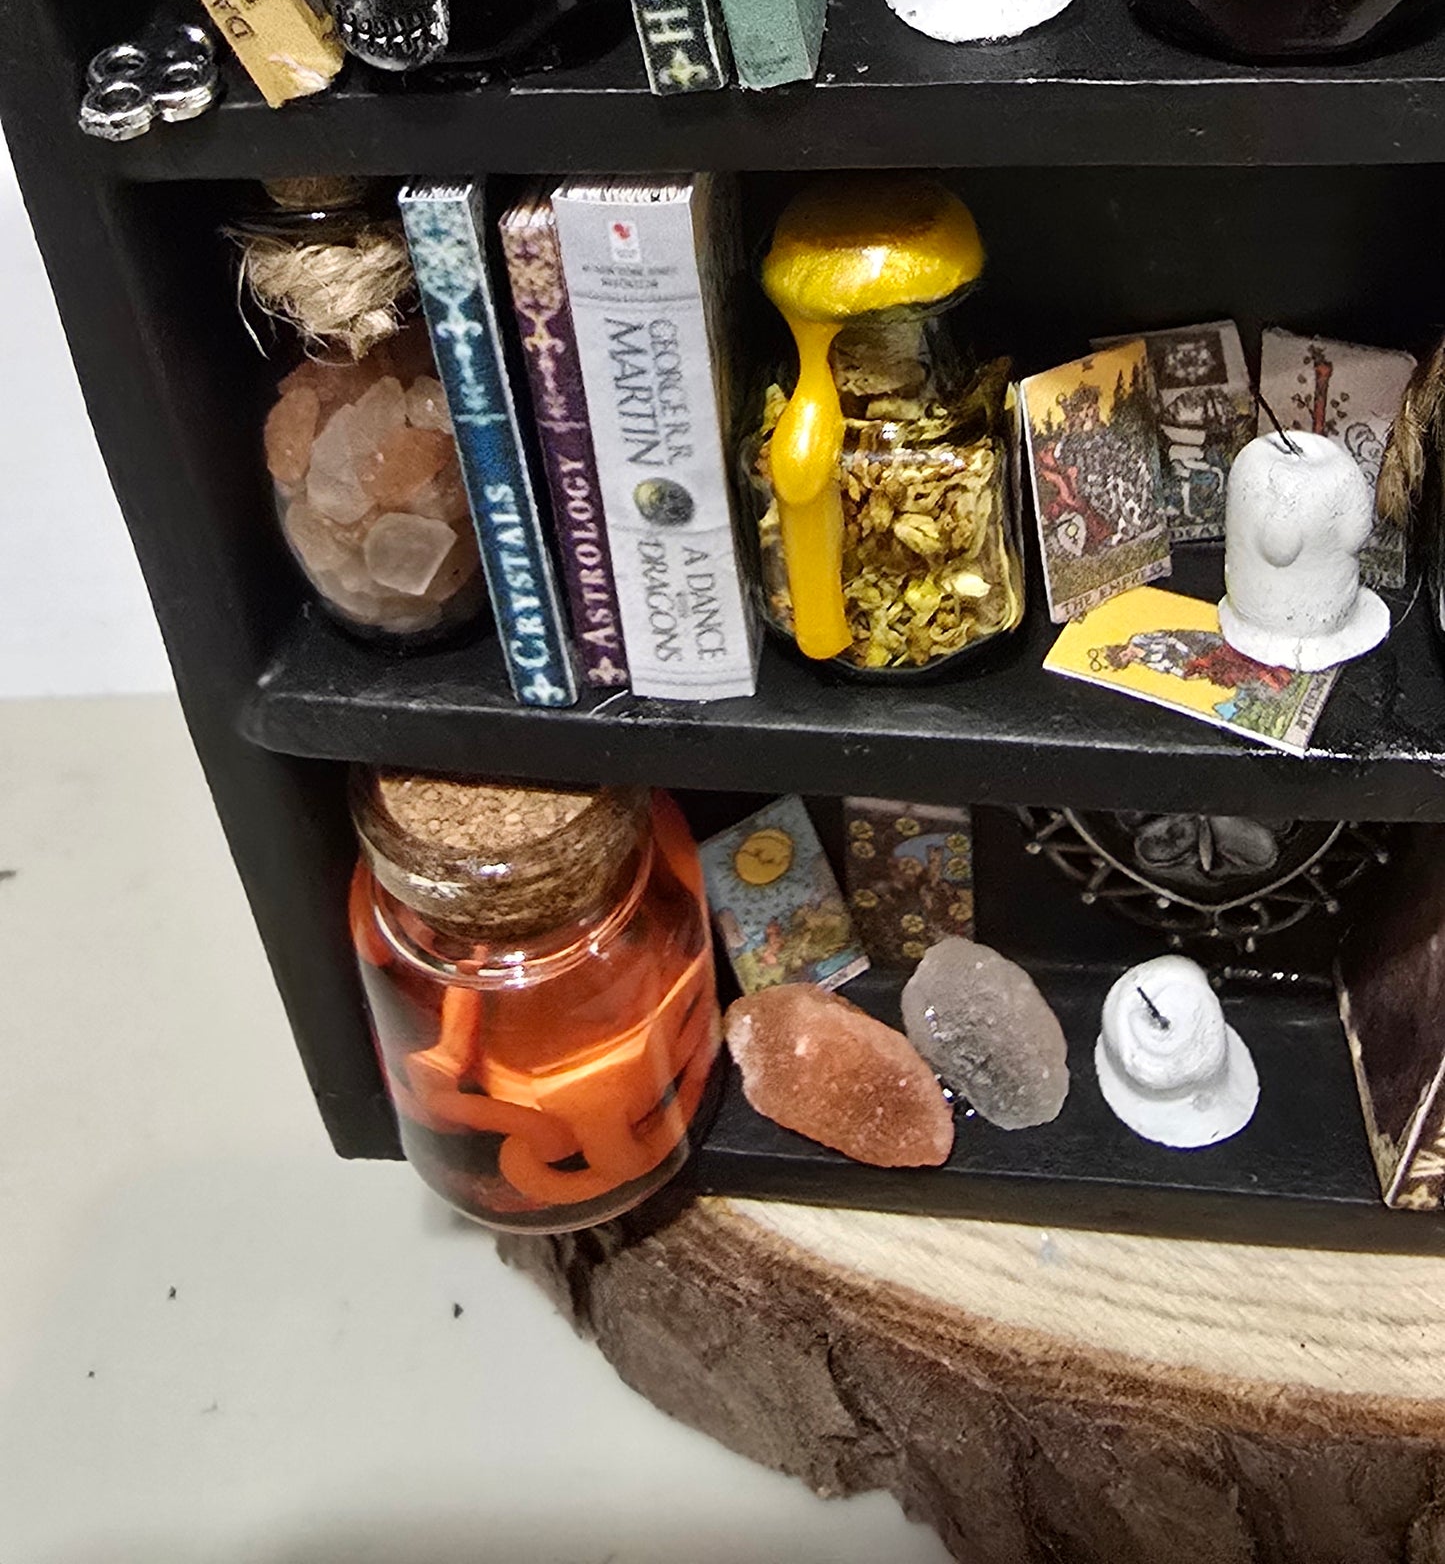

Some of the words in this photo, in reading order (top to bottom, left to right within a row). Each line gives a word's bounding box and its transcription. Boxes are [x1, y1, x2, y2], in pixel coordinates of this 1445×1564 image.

[603, 313, 667, 470] MARTIN
[646, 316, 692, 418] GEORGE
[482, 480, 551, 672] CRYSTALS
[556, 455, 619, 654] ASTROLOGY
[636, 536, 683, 664] DRAGONS
[681, 543, 708, 566] A
[683, 569, 729, 661] DANCE
